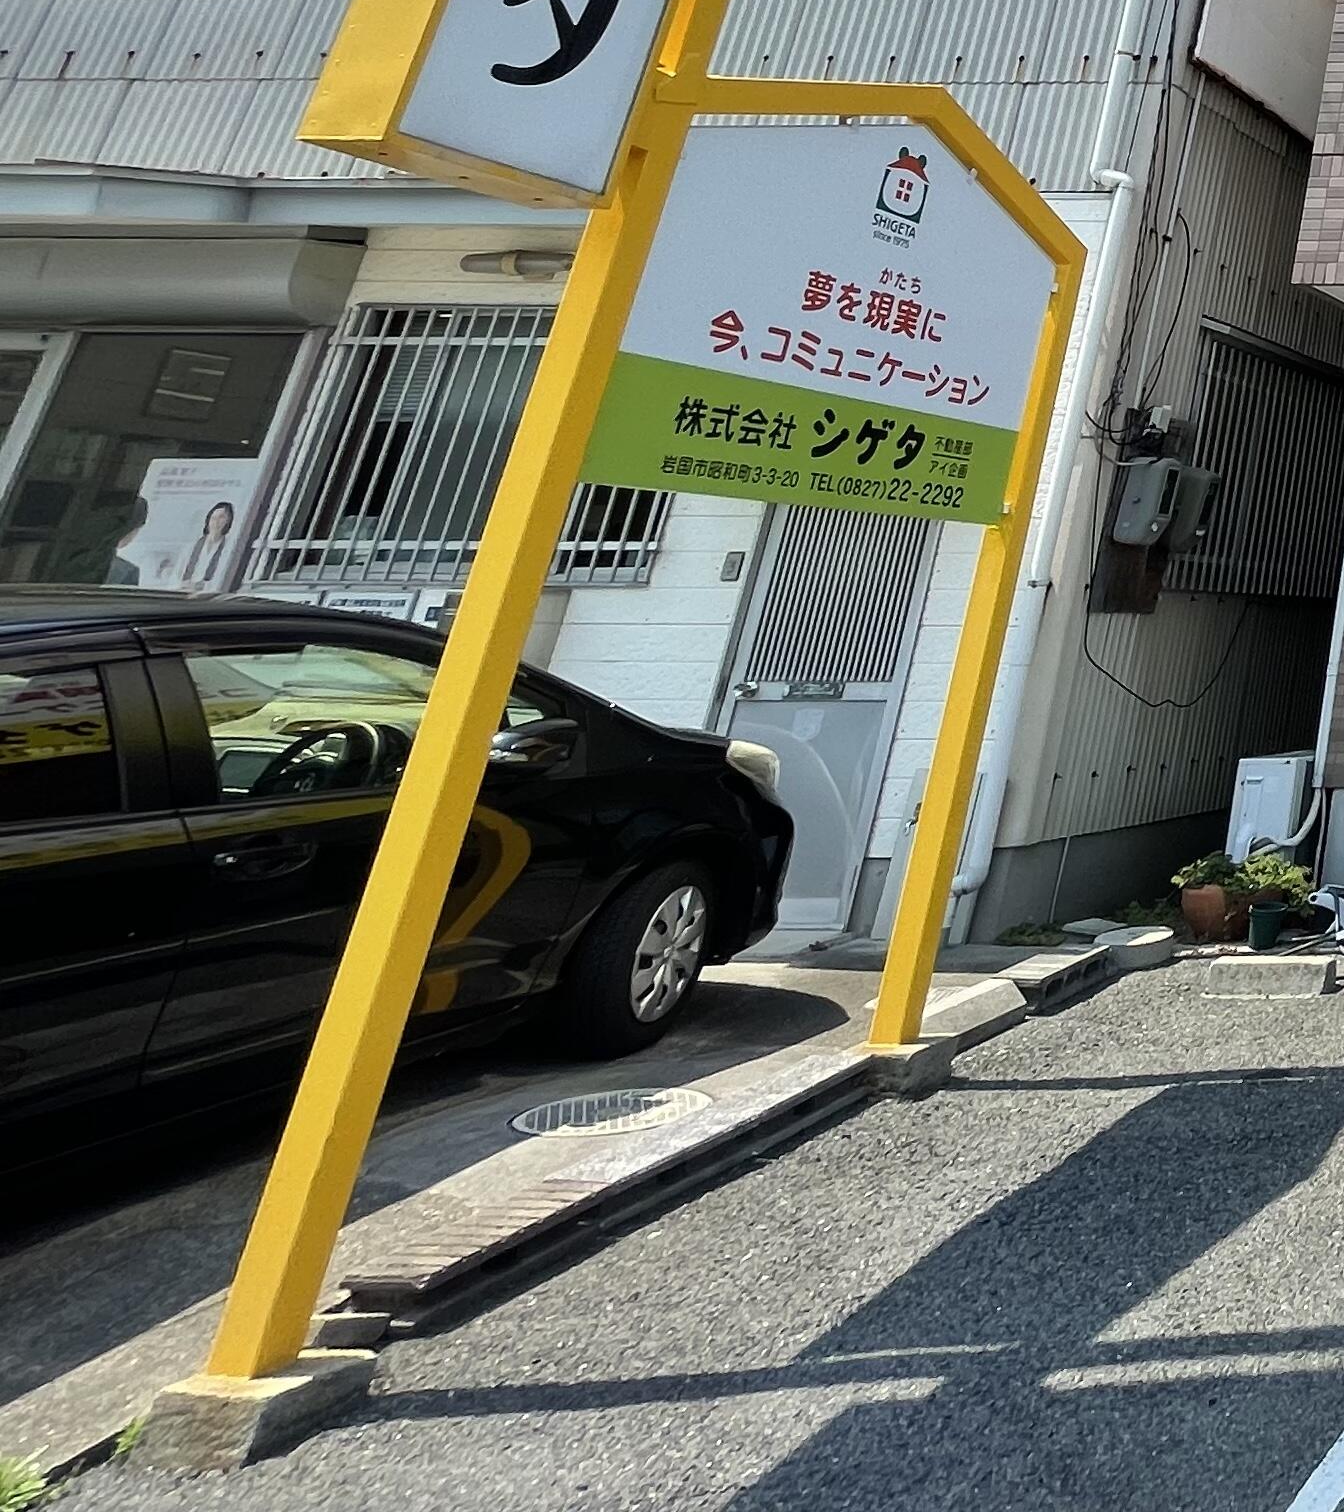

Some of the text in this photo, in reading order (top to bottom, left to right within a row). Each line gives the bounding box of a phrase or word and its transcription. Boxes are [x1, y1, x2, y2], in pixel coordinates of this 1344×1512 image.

[872, 213, 916, 239] SHIGETA
[879, 267, 922, 294] かたち
[800, 270, 948, 344] 夢を現実に
[709, 310, 991, 406] 今、コミュニケーション
[673, 395, 927, 471] 株式会社 シゲタ
[929, 460, 968, 479] アイ企画
